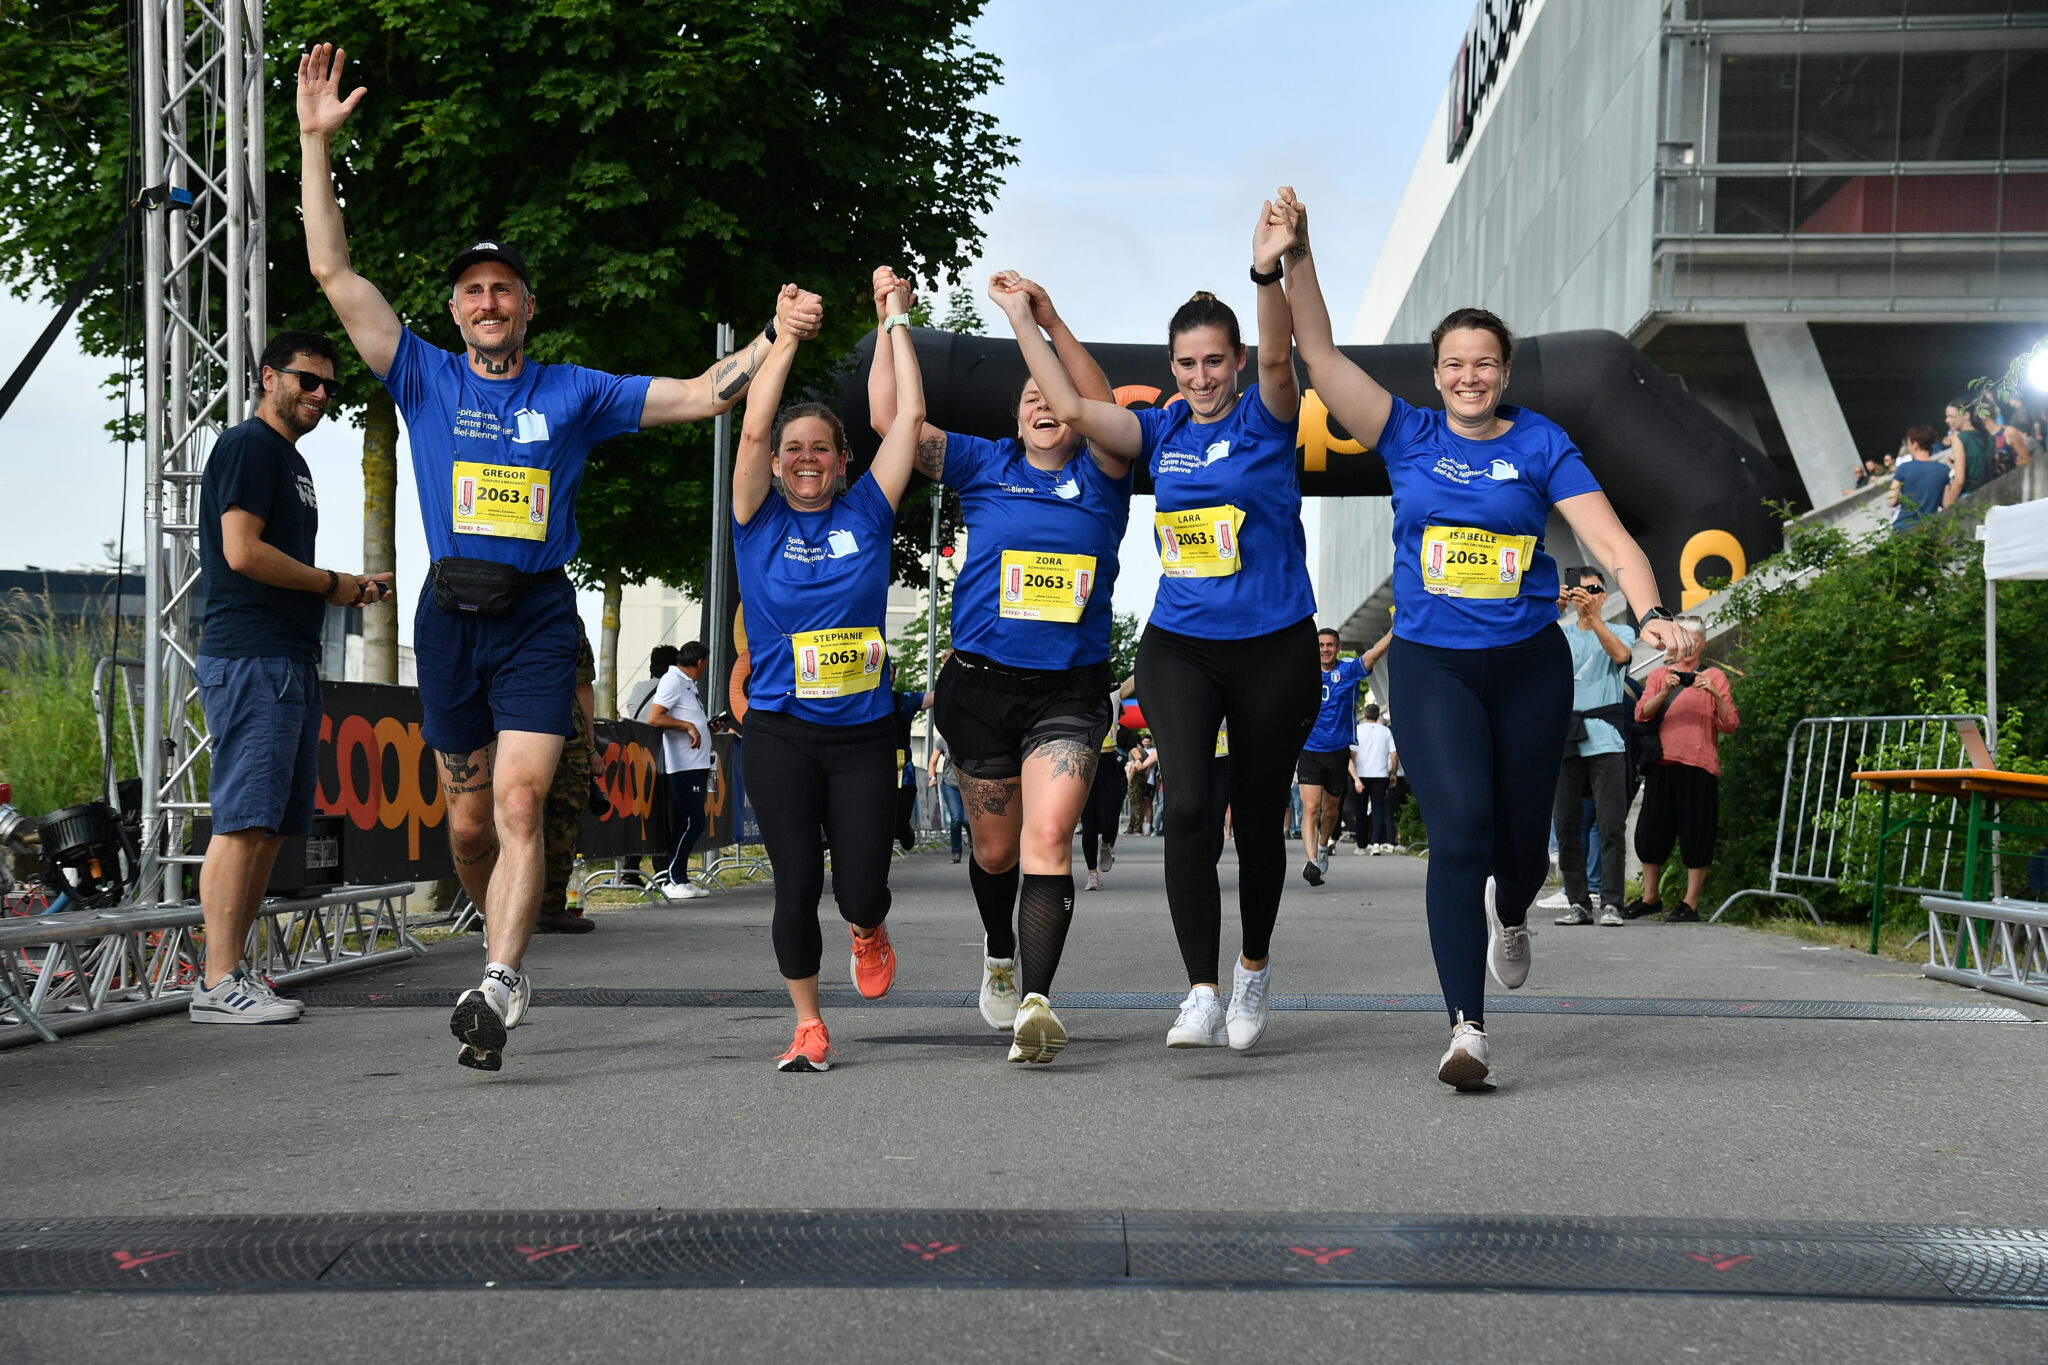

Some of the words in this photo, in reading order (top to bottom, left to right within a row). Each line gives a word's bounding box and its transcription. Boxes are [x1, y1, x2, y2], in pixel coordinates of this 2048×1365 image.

[453, 426, 498, 440] Biel-Bienne
[482, 468, 526, 480] GREGOR
[1432, 466, 1470, 485] Biel-Bienne
[477, 487, 520, 504] 2063
[522, 495, 530, 505] 4
[1177, 514, 1201, 524] LARA
[1175, 532, 1207, 546] 2063
[1209, 535, 1215, 544] 3
[1449, 531, 1497, 544] ISABELLE
[1035, 556, 1062, 566] ZORA
[1446, 550, 1489, 565] 2063
[1024, 574, 1064, 589] 2063
[1066, 581, 1073, 590] 5
[813, 631, 864, 644] STEPHANIE
[819, 649, 858, 666] 2063
[859, 652, 865, 661] 1
